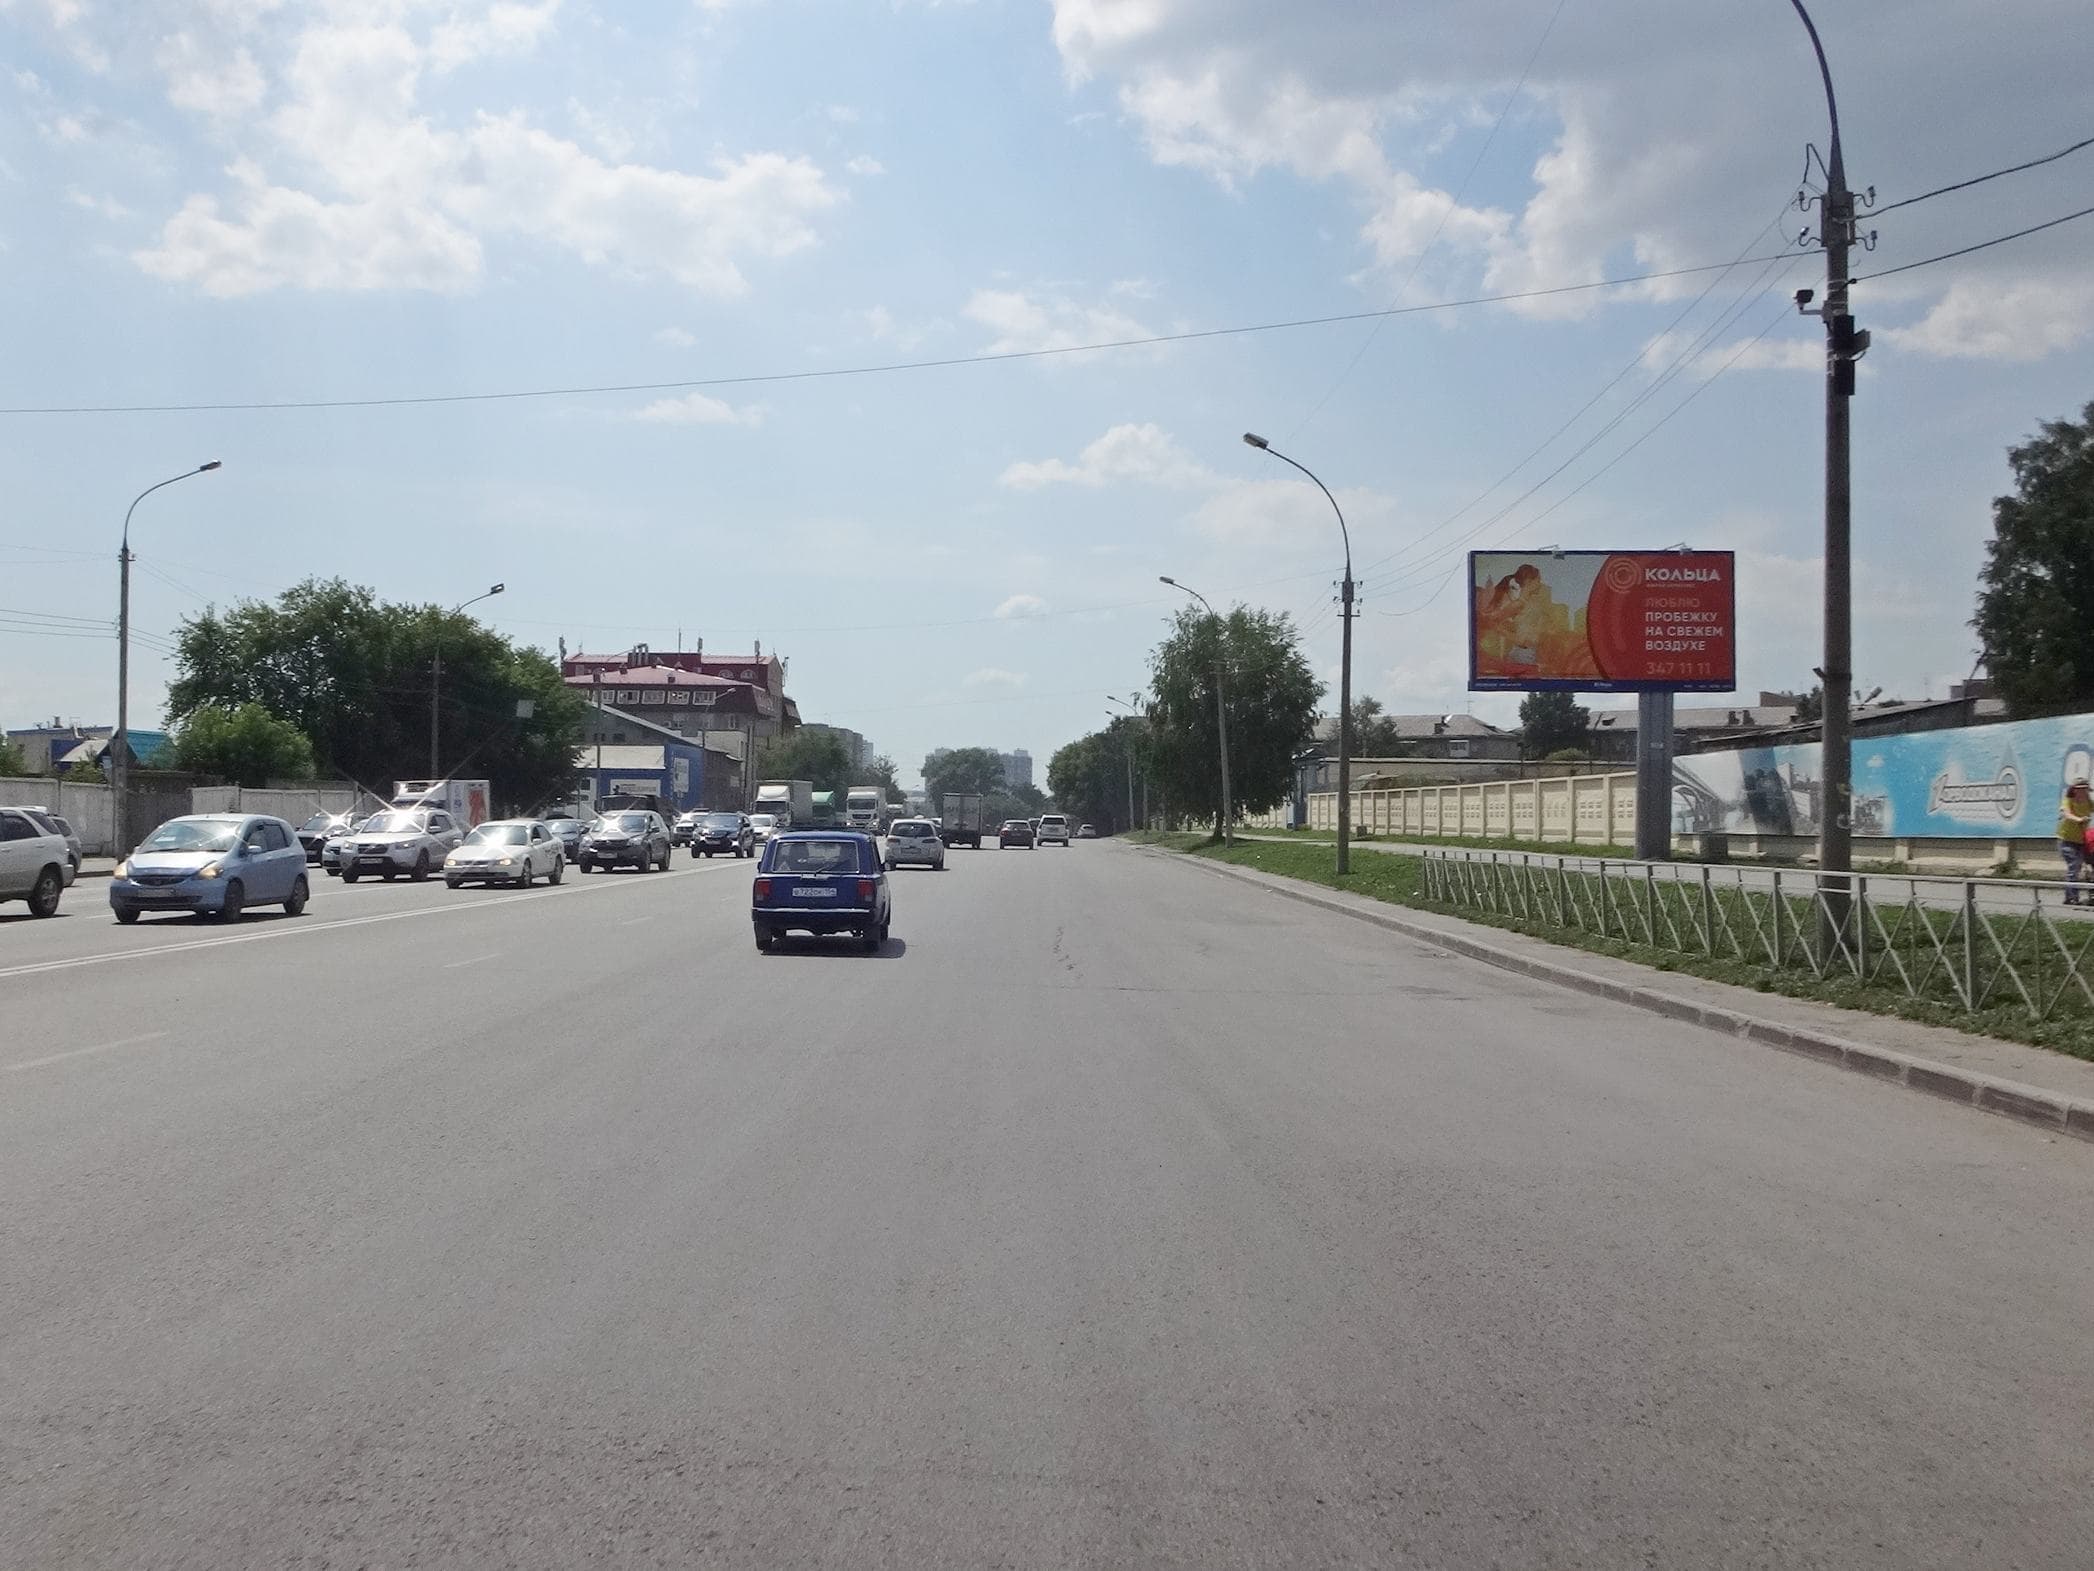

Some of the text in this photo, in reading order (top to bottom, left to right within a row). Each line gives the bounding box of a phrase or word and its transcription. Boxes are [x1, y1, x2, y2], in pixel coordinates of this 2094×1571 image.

[1645, 568, 1720, 582] КОЛЬЦА
[1645, 598, 1700, 608] ЛЮБЛЮ
[1645, 612, 1718, 622] ПРОБЕЖКУ
[1646, 626, 1723, 637] НА СВЕЖЕМ
[1645, 641, 1706, 652] ВОЗДУХЕ
[1646, 662, 1711, 675] 347 11 11
